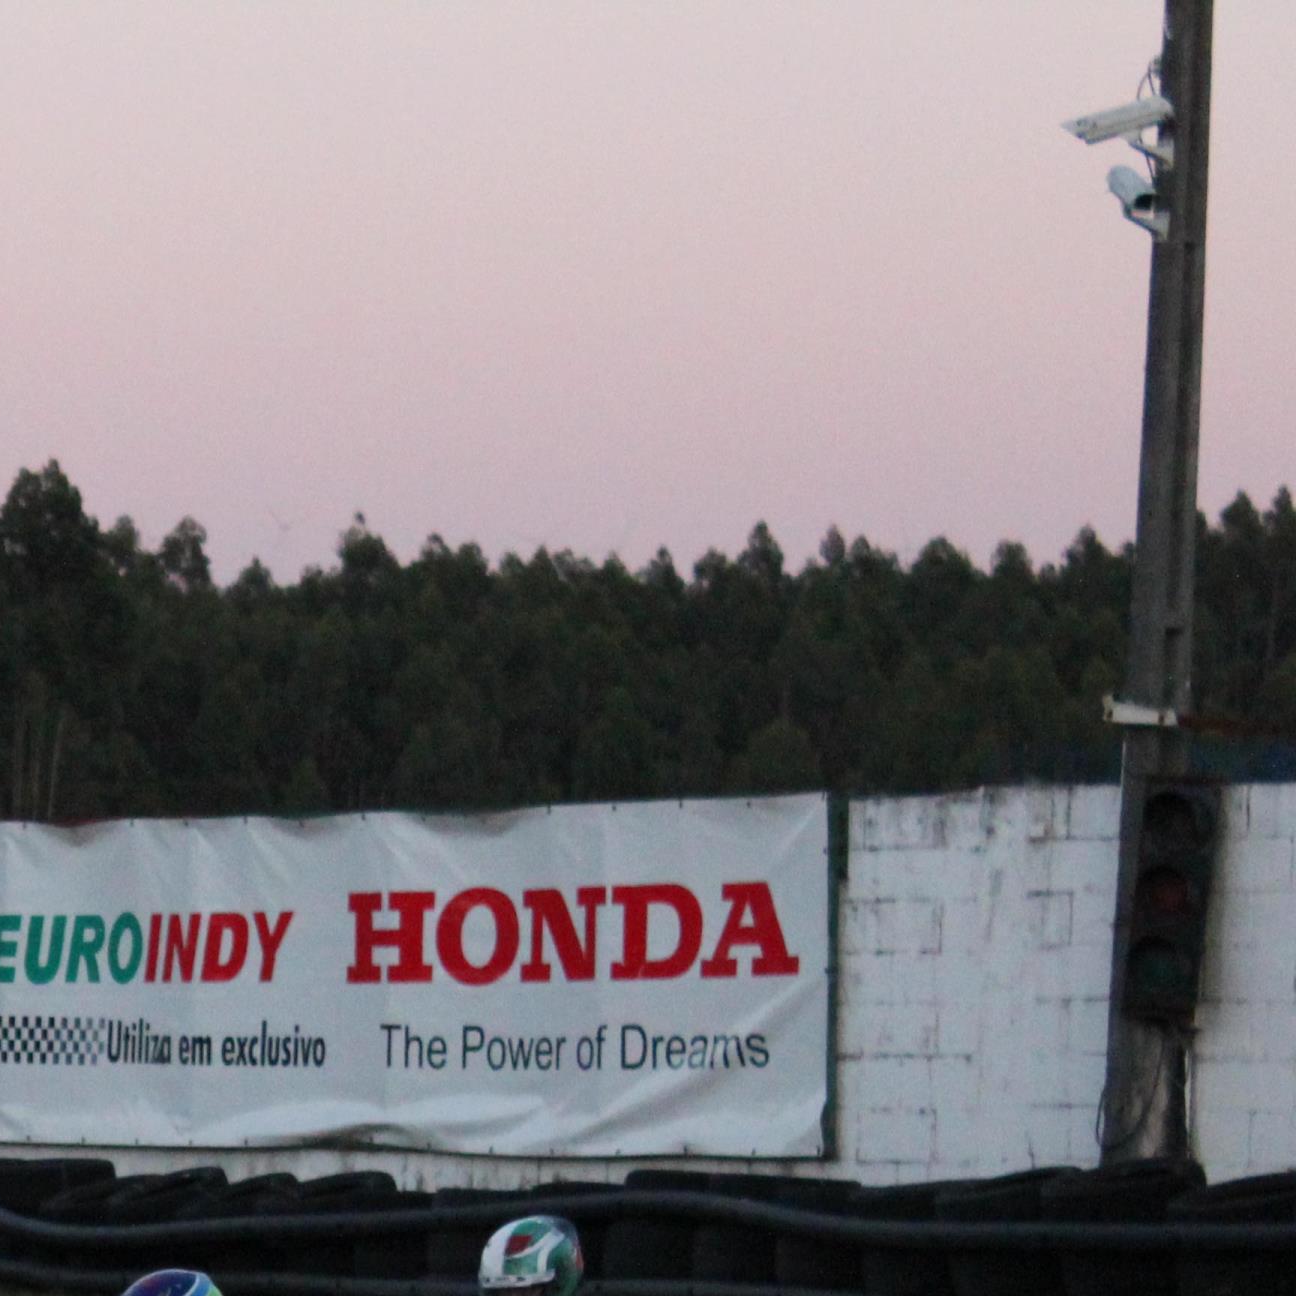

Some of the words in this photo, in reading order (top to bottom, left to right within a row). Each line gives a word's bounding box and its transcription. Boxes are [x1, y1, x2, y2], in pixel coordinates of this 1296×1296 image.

[347, 881, 800, 987] HONDA
[107, 1017, 172, 1065] Utiliza
[177, 1033, 213, 1067] em
[220, 1019, 327, 1068] exclusivo
[379, 1023, 447, 1070] The
[461, 1024, 567, 1071] Power
[575, 1024, 609, 1071] of
[619, 1022, 771, 1070] Dreams
